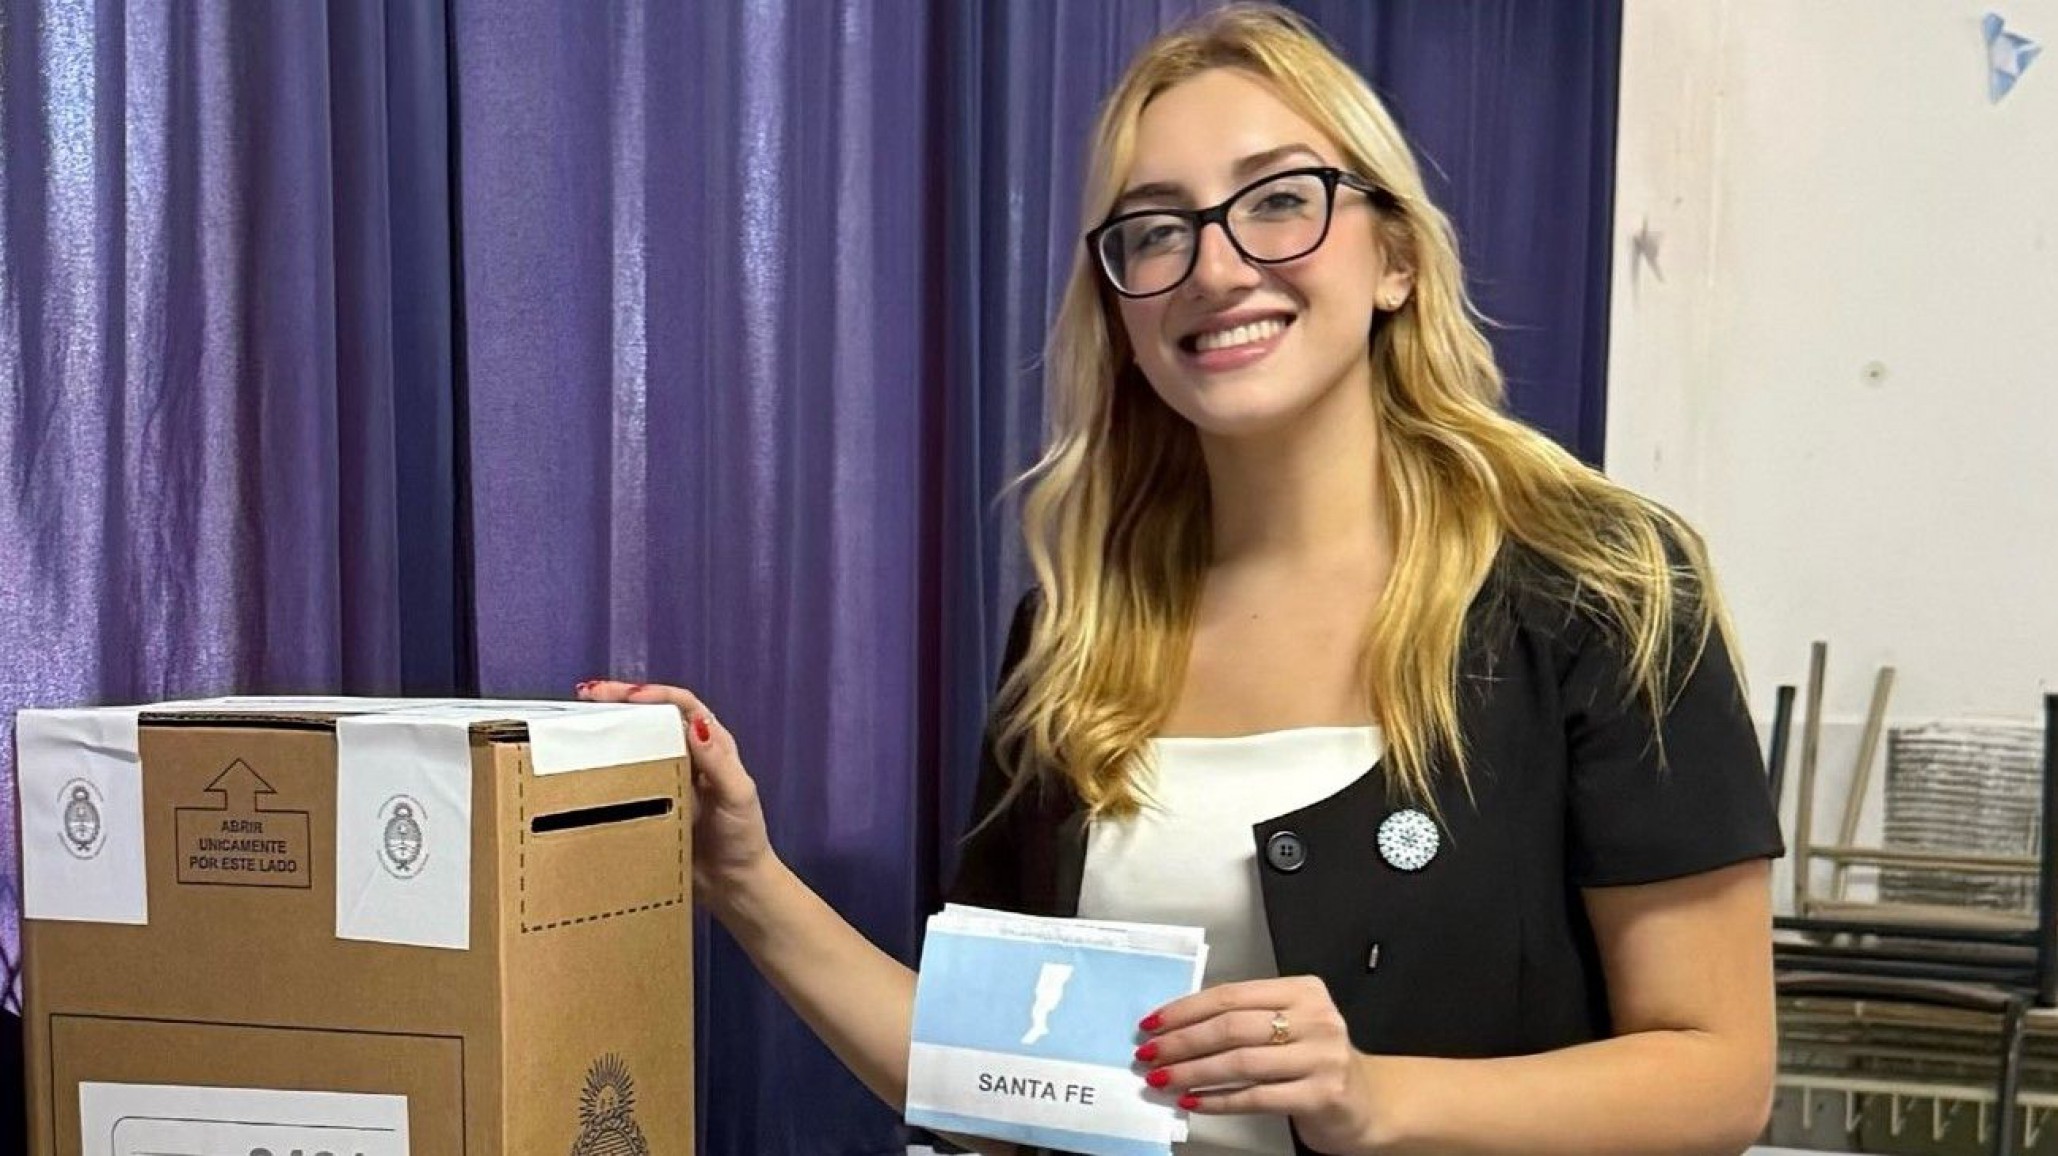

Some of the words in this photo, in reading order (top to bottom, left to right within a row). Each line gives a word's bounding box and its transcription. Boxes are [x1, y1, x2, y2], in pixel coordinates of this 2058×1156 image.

[221, 820, 264, 834] ABRIR
[199, 838, 287, 854] UNICAMENTE
[189, 856, 218, 870] POR
[221, 858, 256, 872] ESTE
[260, 860, 297, 873] LADO
[978, 1073, 1056, 1101] SANTA
[1065, 1084, 1096, 1105] FE
